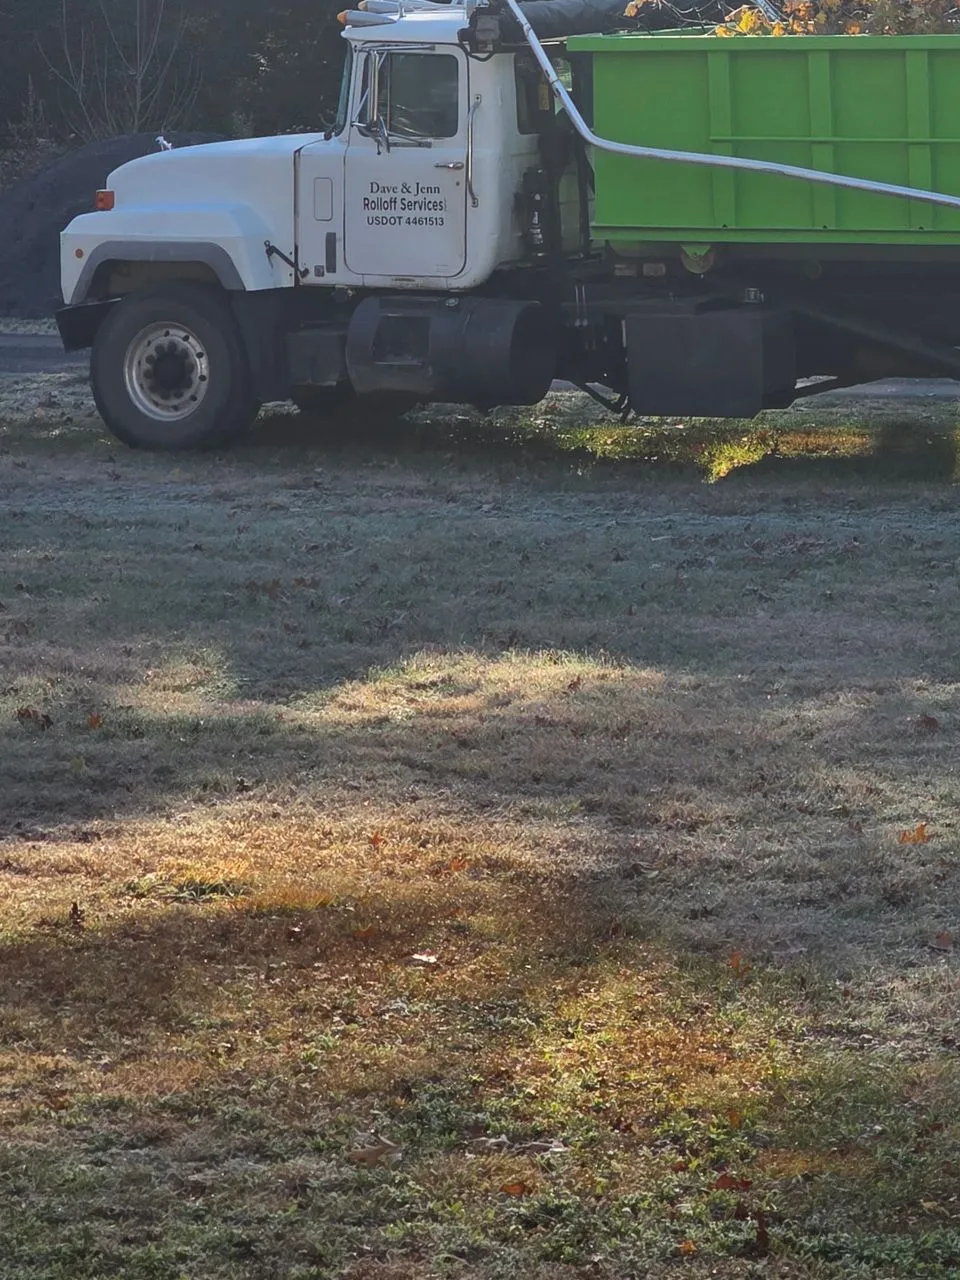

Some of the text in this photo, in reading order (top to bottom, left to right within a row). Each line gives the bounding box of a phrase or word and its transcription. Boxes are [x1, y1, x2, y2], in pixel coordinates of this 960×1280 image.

[370, 181, 440, 196] Dave & Jenn
[363, 197, 397, 211] Rolloff
[400, 197, 443, 211] Services
[367, 216, 444, 226] USDOT 4461513
